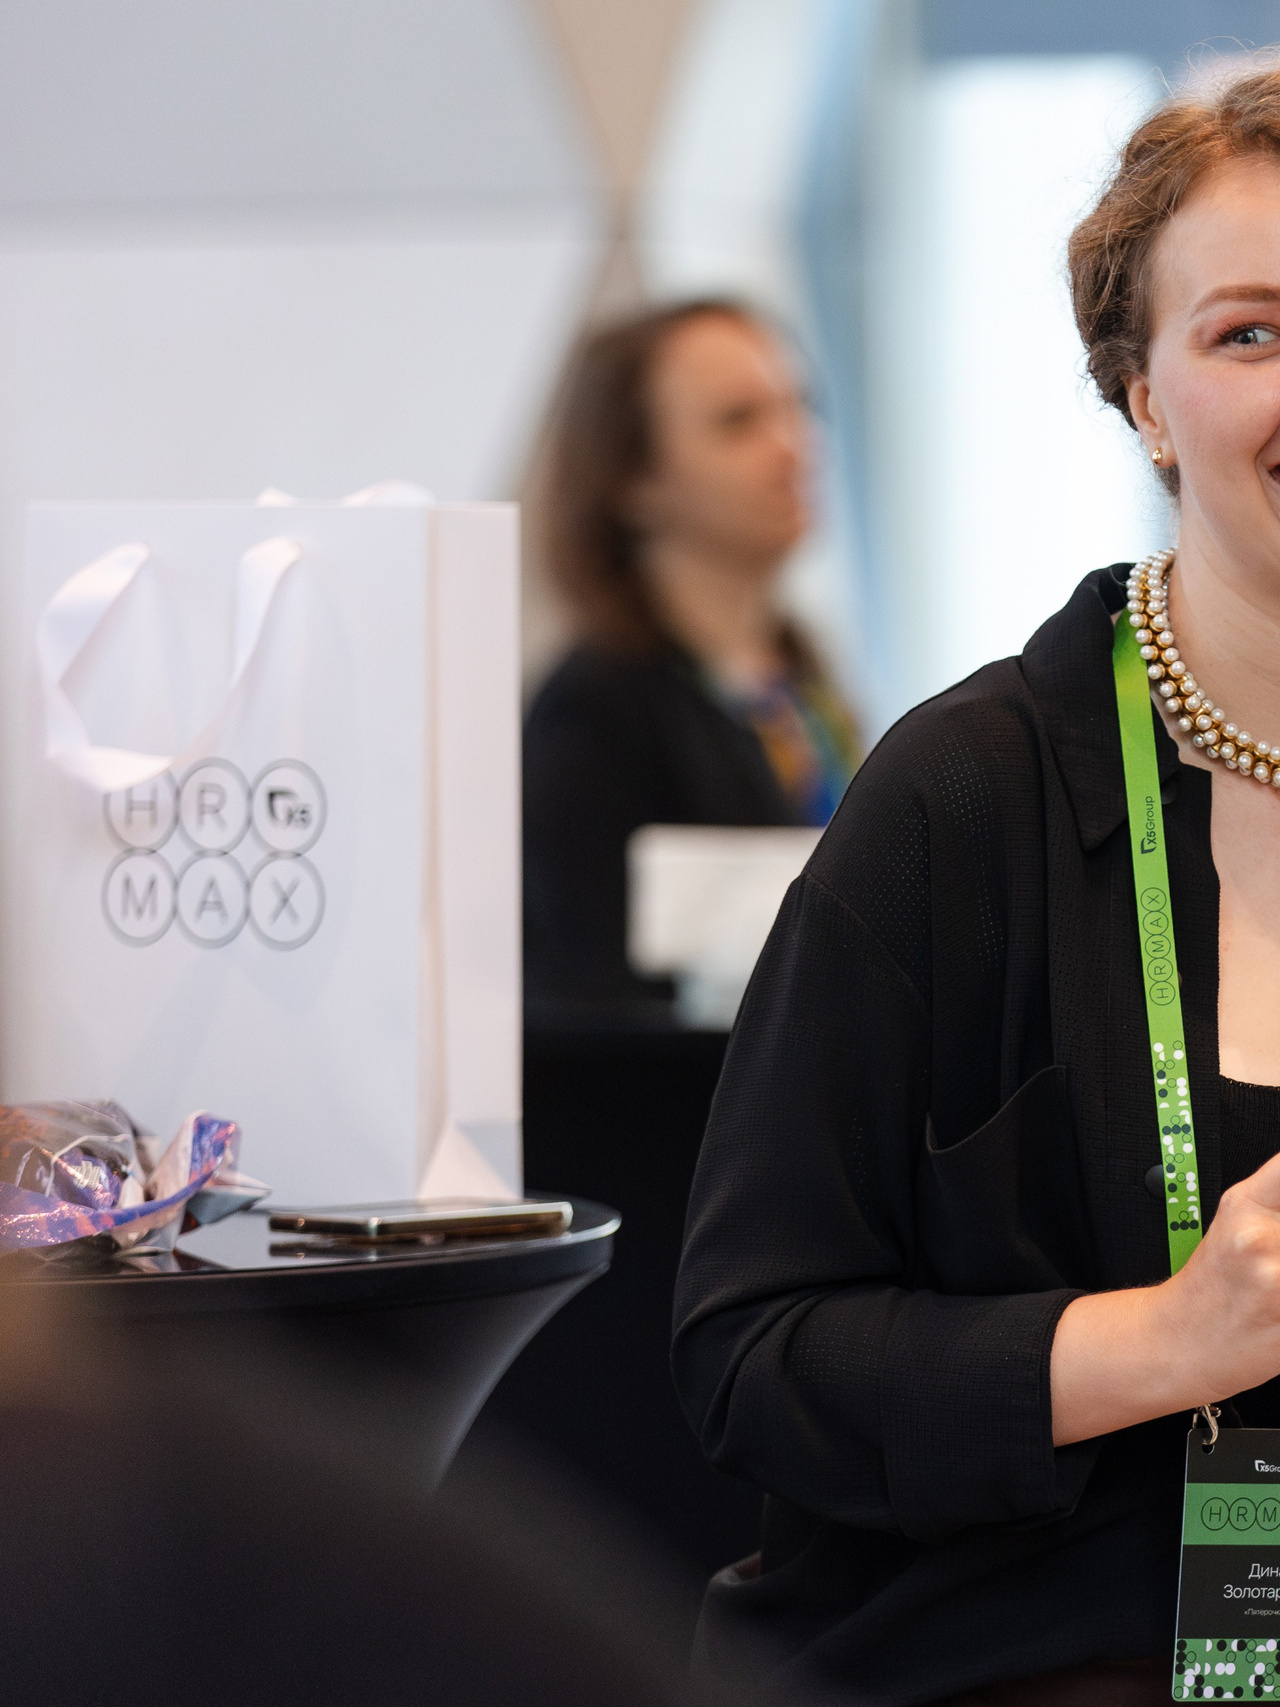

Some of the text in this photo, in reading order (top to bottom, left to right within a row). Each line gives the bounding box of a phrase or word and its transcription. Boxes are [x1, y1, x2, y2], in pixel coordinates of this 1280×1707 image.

[123, 781, 228, 829] HR
[1145, 795, 1157, 845] X5Group
[119, 872, 302, 924] MAX
